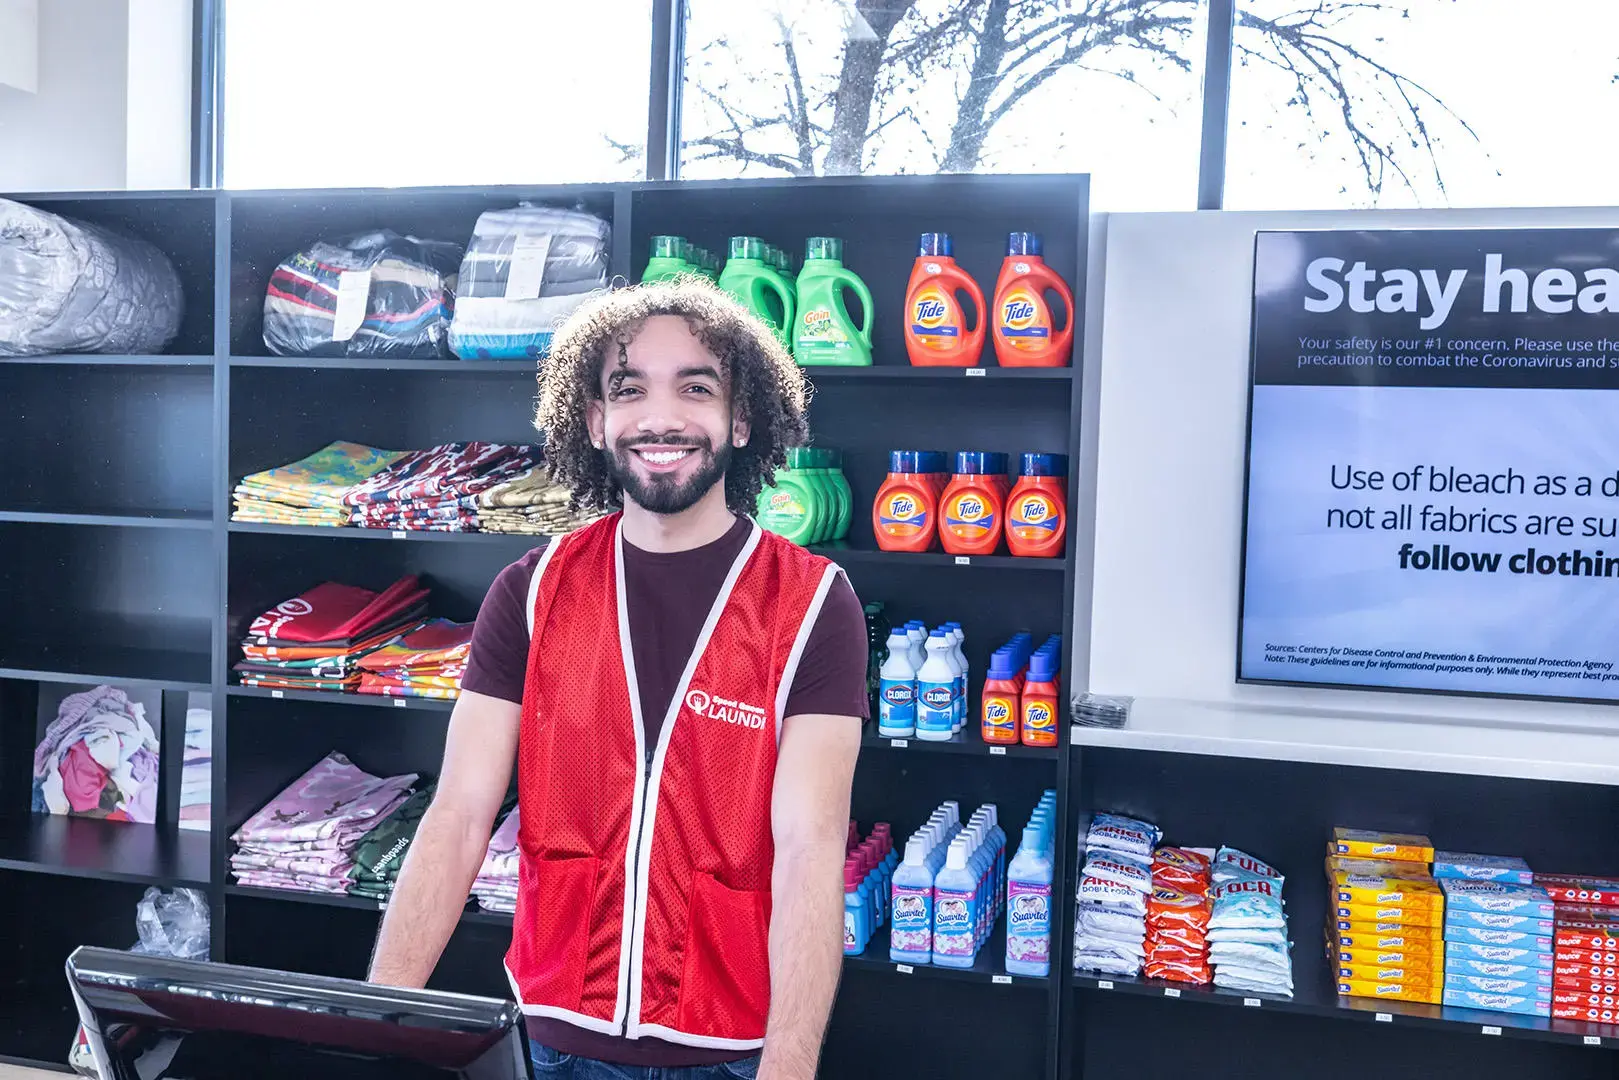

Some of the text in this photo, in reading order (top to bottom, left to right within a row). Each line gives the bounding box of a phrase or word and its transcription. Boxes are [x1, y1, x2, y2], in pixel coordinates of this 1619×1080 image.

[1304, 253, 1619, 330] Stay hea
[804, 311, 830, 324] Gain
[917, 301, 945, 321] Tide
[1005, 302, 1034, 323] Tide
[1298, 336, 1331, 349] Your
[1335, 336, 1378, 353] safety
[1381, 337, 1392, 349] is
[1396, 339, 1420, 349] our
[1424, 337, 1441, 349] #1
[1447, 339, 1510, 350] concern.
[1515, 338, 1563, 351] Please
[1566, 341, 1593, 351] use
[1298, 353, 1374, 368] precaution
[1378, 354, 1392, 366] to
[1396, 353, 1450, 366] combat
[1455, 354, 1479, 366] the
[1482, 354, 1573, 368] Coronavirus
[1576, 354, 1606, 368] and
[1331, 464, 1384, 490] Use
[1392, 465, 1424, 491] of
[1429, 466, 1525, 495] bleach
[1533, 475, 1567, 496] as
[1574, 476, 1592, 497] a
[772, 494, 791, 504] Gain
[892, 501, 913, 514] Tide
[959, 502, 982, 516] Tide
[1023, 503, 1045, 518] Tide
[1327, 504, 1617, 537] not all fabrics are su
[1398, 543, 1502, 572] follow
[1265, 643, 1614, 671] Sources: Centers for Disease Control and Prevention & Environmental Protection Agency
[1264, 654, 1285, 663] Note:
[1287, 655, 1309, 664] These
[1310, 656, 1350, 667] guidelines
[1365, 659, 1378, 669] for
[1379, 659, 1435, 671] informational
[1435, 663, 1474, 673] purposes
[1475, 665, 1495, 676] only.
[1496, 666, 1520, 676] While
[1521, 668, 1540, 678] they
[1541, 669, 1581, 679] represent
[1582, 671, 1601, 680] best
[887, 690, 912, 699] CLOROX
[926, 692, 951, 702] CLOROX
[986, 705, 1007, 719] Tide
[1028, 707, 1048, 722] Tide
[1094, 826, 1146, 841] ARIEL
[1093, 860, 1146, 877] ARIEL
[1216, 881, 1272, 898] FOCA
[895, 909, 925, 919] Suavitel
[937, 913, 968, 923] Suavitel
[1012, 911, 1048, 923] Suavitel
